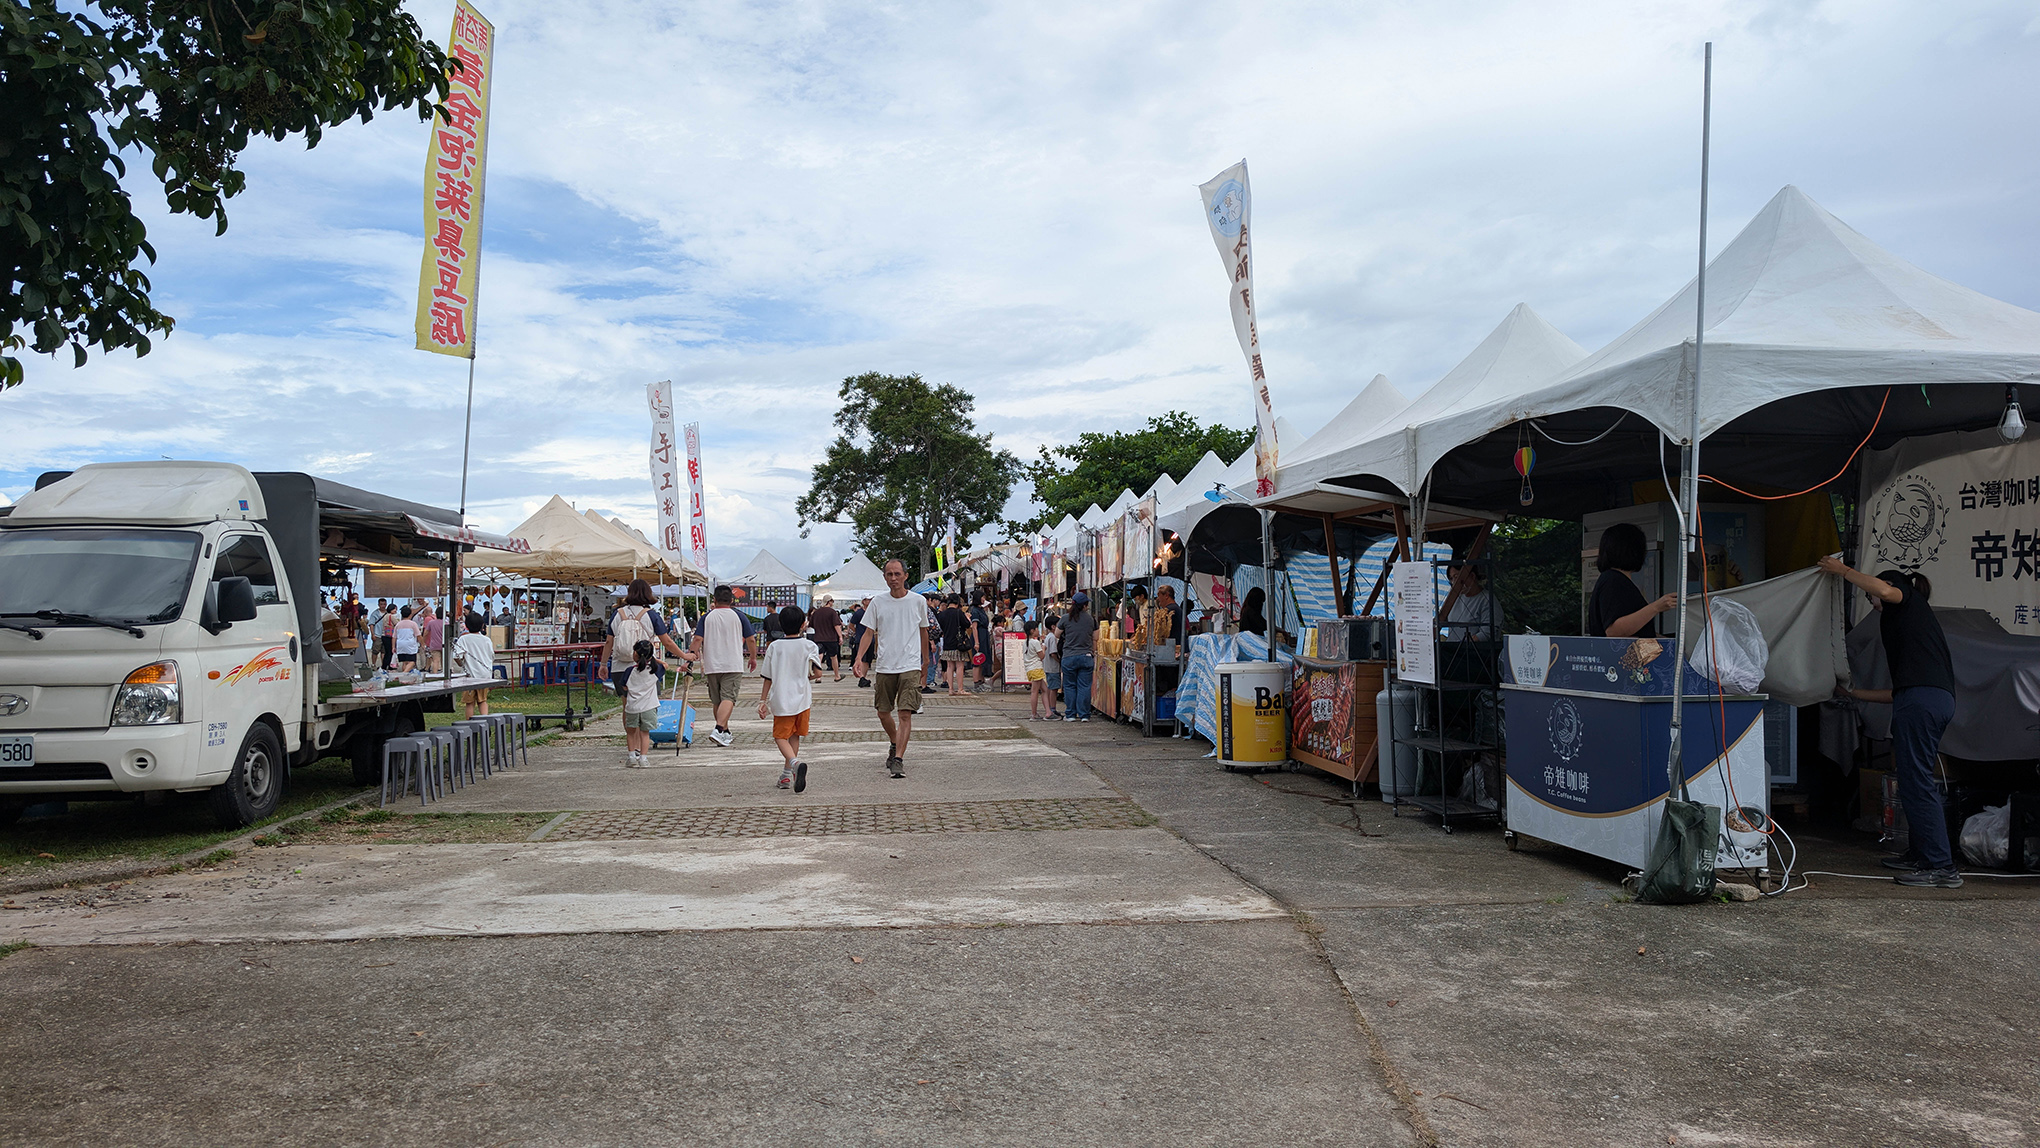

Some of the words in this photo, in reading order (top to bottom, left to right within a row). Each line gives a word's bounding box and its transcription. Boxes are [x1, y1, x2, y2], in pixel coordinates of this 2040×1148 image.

[654, 431, 680, 552] 手工粉圓
[1882, 477, 1904, 497] LOCAL
[1915, 474, 1937, 491] FRESH
[208, 722, 228, 732] CBH-7580
[0, 743, 32, 761] 580
[1543, 764, 1590, 795] 帝雉咖啡
[1547, 788, 1556, 796] T.C.
[1556, 791, 1573, 800] Coffee
[1573, 795, 1587, 804] beans
